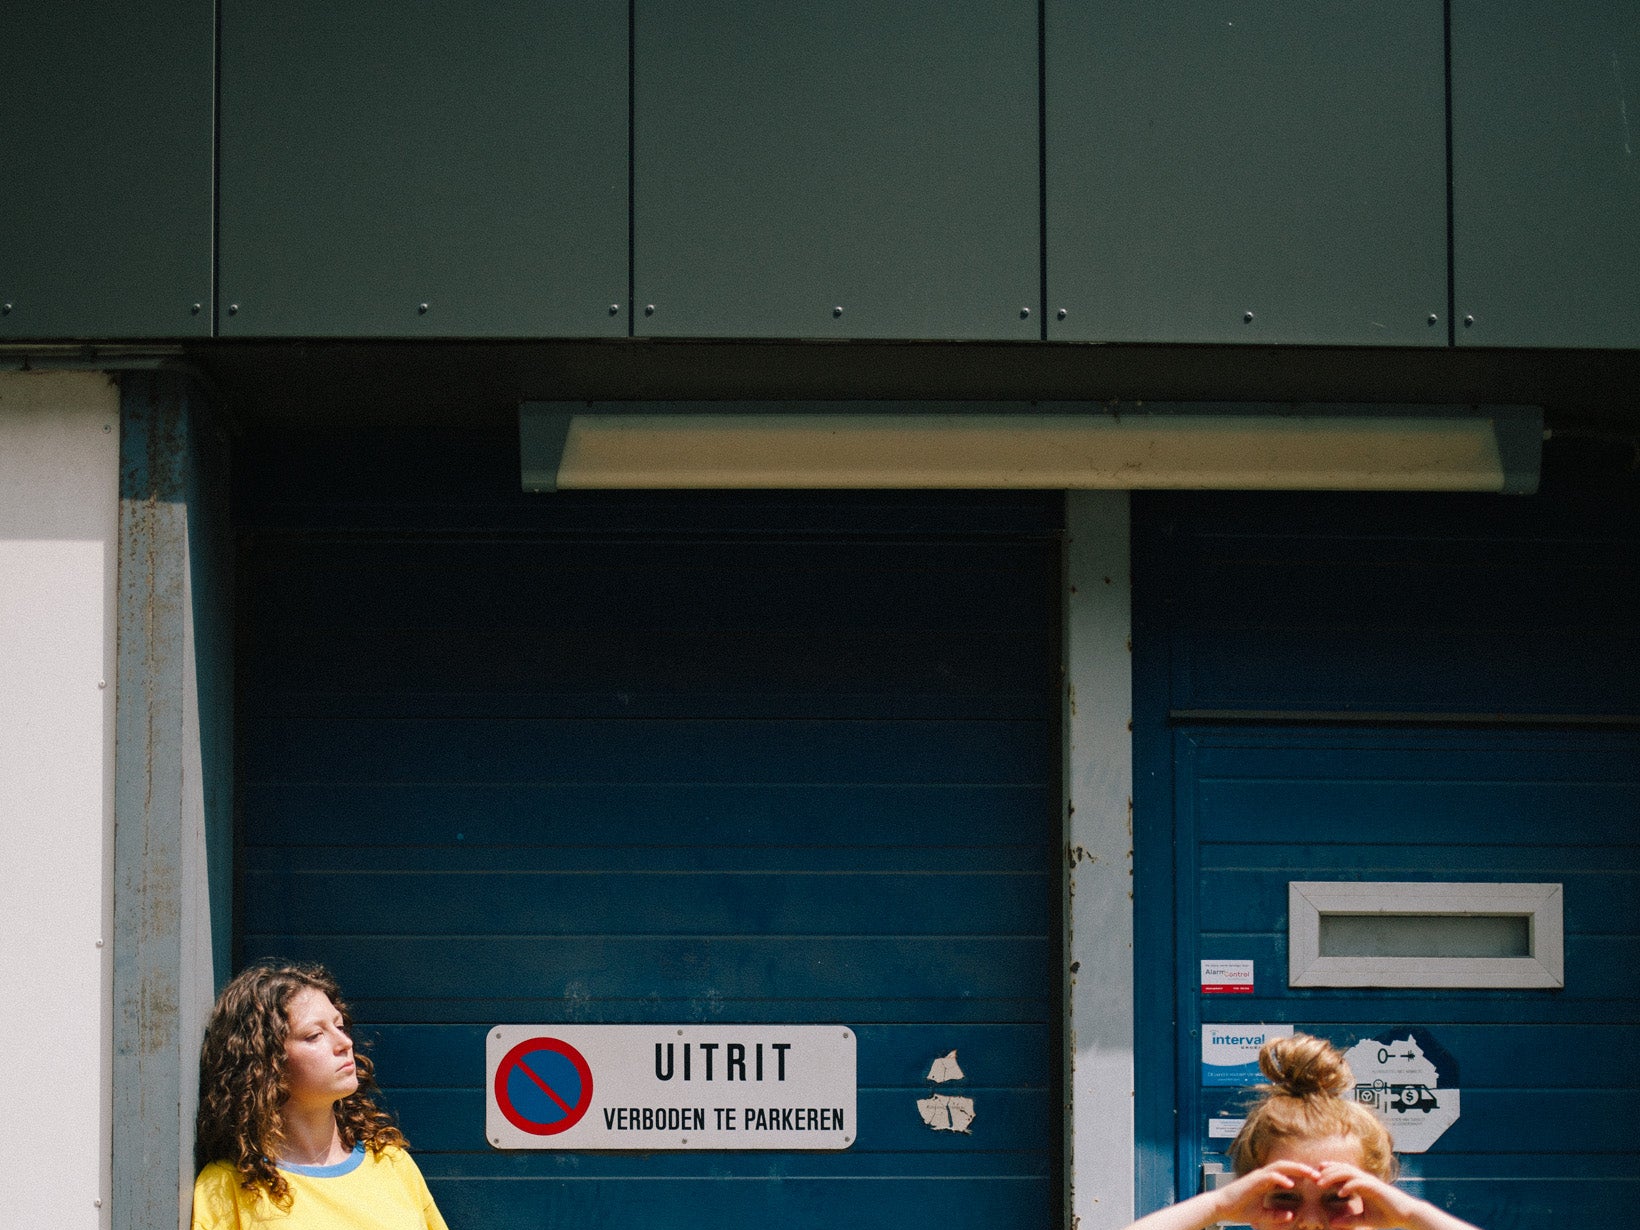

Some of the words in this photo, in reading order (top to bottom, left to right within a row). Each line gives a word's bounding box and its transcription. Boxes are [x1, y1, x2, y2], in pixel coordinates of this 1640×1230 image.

[1212, 1032, 1265, 1045] interval
[655, 1043, 791, 1081] UITRIT
[603, 1108, 705, 1130] VERBODEN
[714, 1108, 736, 1130] TE
[744, 1108, 844, 1131] PARKEREN
